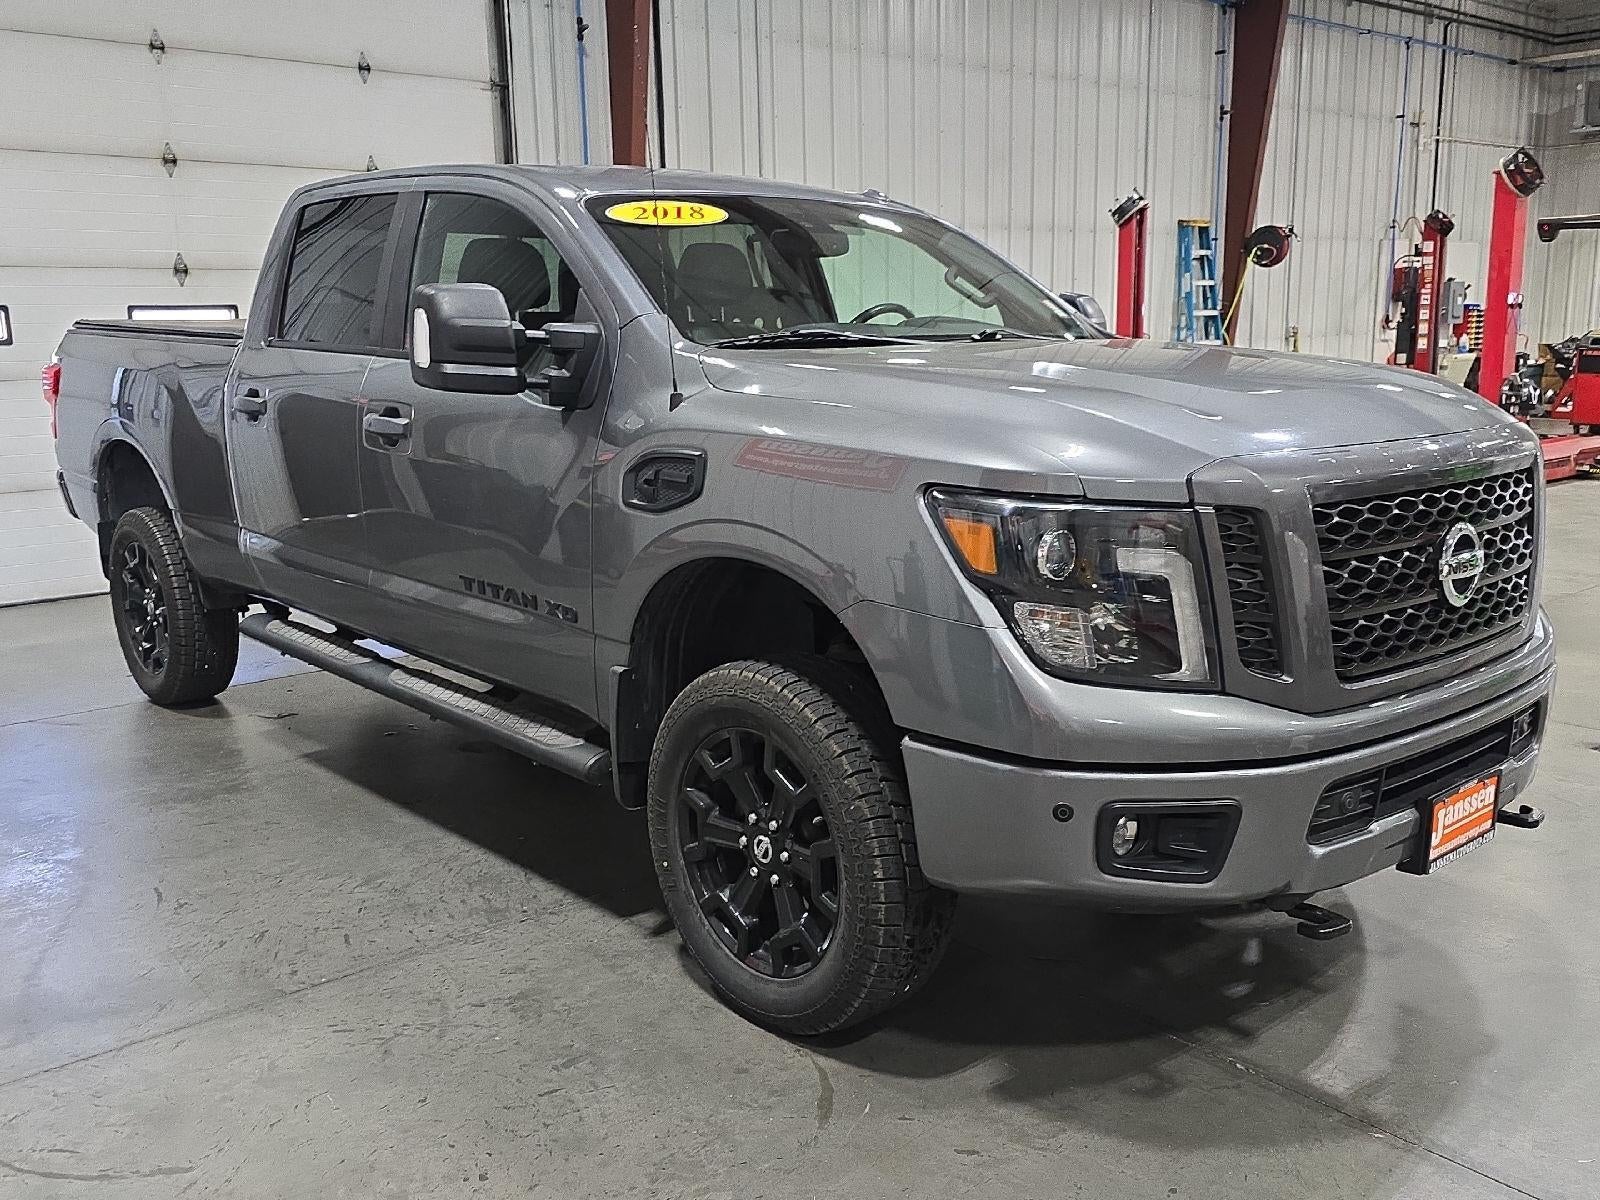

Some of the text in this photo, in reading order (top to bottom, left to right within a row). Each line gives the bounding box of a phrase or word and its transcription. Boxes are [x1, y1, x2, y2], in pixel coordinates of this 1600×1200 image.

[632, 205, 705, 220] 2018
[459, 574, 579, 623] TITAN XD
[1431, 784, 1496, 847] Janssen
